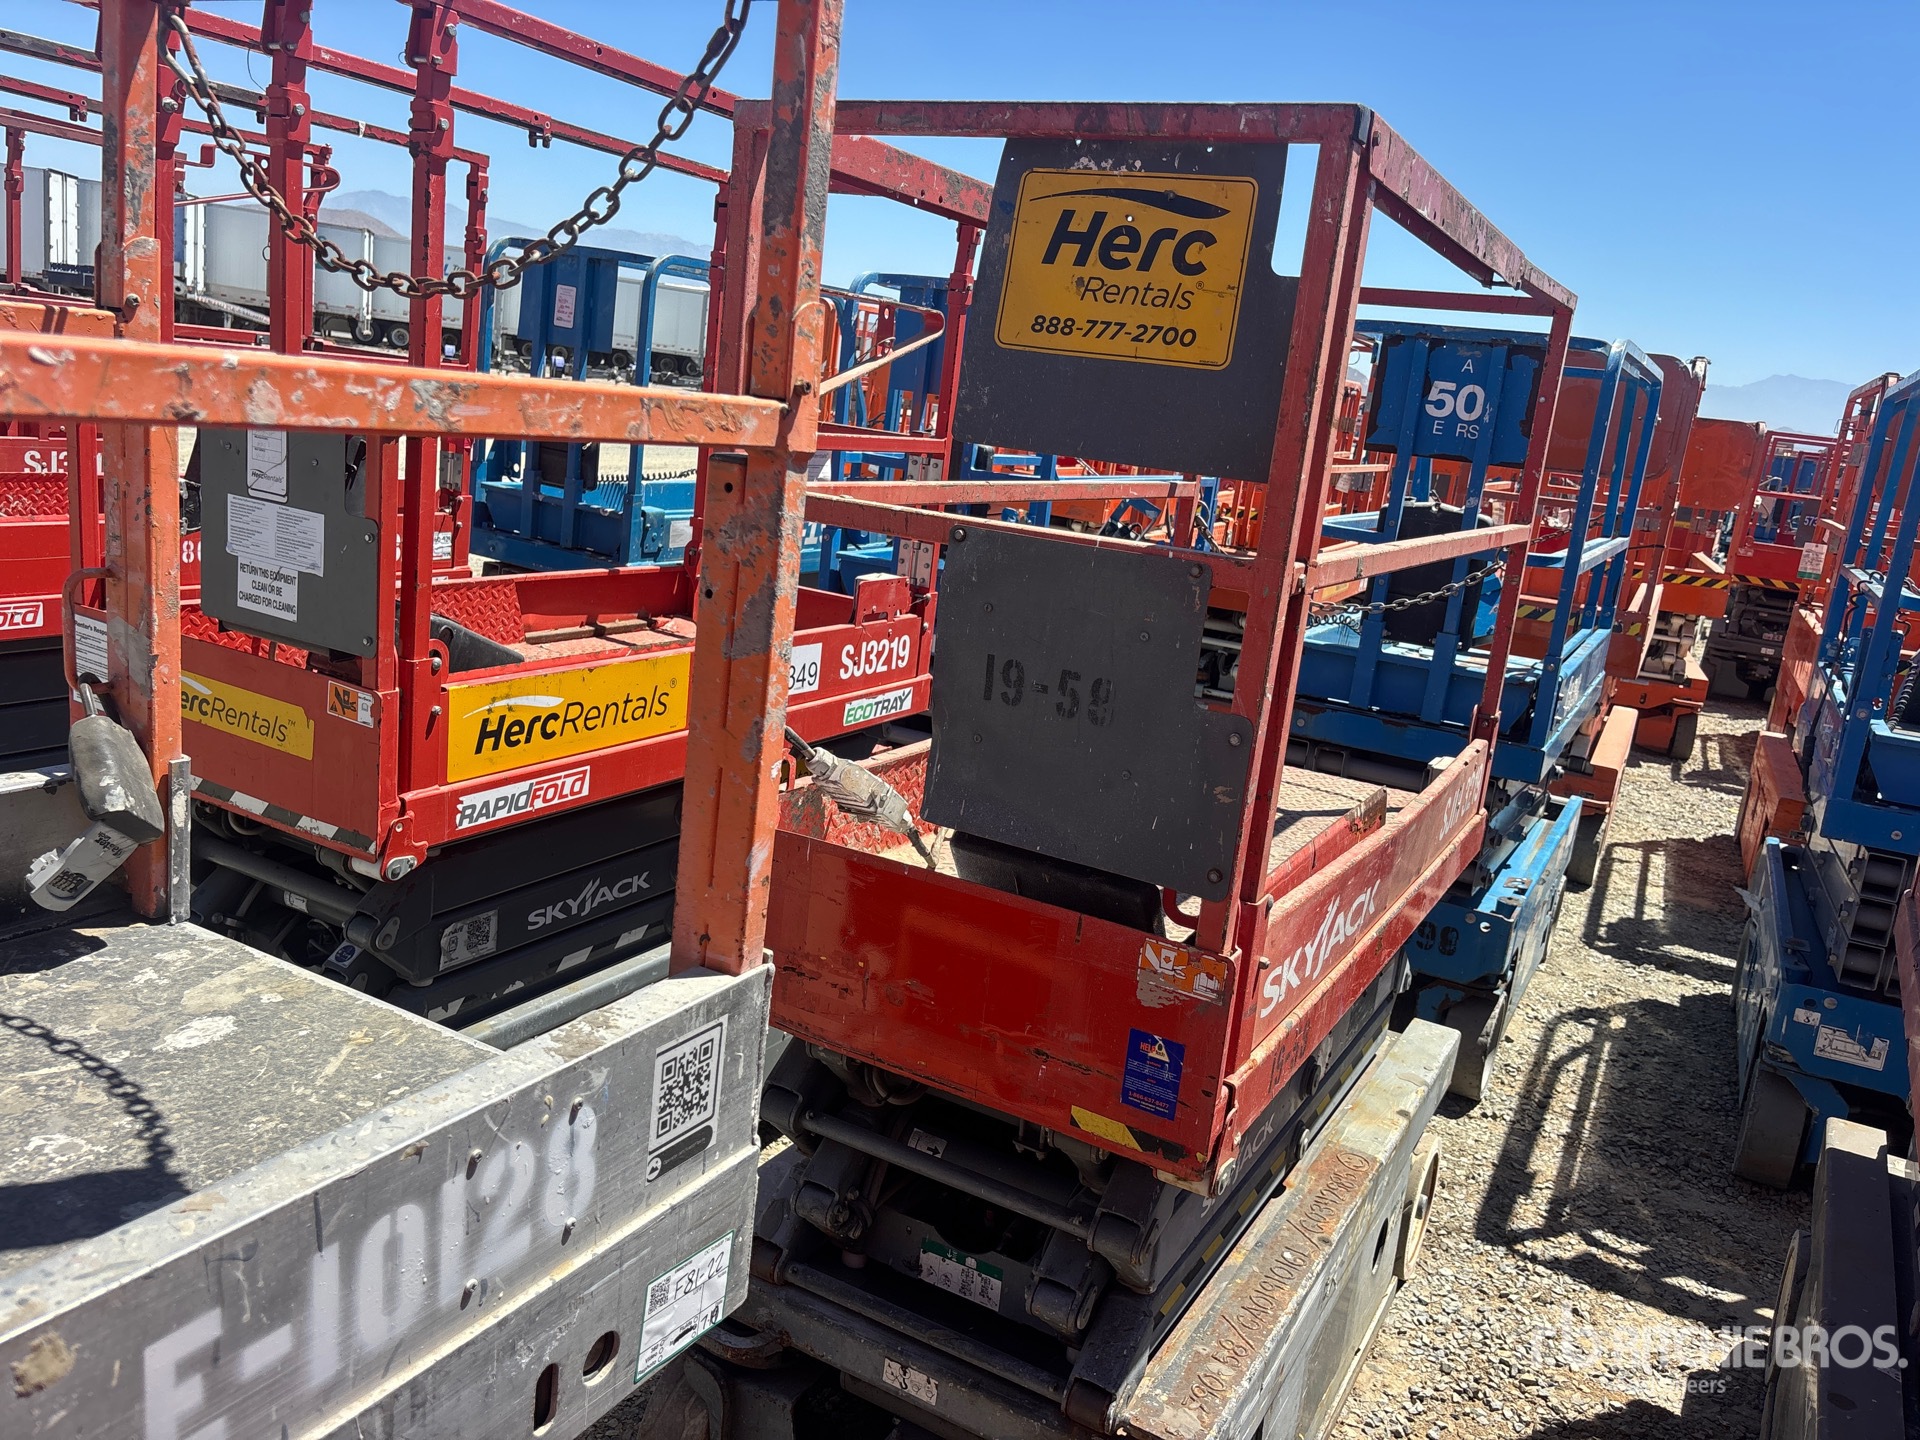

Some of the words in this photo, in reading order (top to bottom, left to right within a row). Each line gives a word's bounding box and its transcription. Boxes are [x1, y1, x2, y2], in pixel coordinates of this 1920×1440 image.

[1041, 209, 1218, 277] Herc
[1080, 276, 1195, 310] Rentals
[1030, 314, 1197, 348] 888-777-2700
[1460, 359, 1474, 374] A
[1425, 380, 1486, 421] 50
[239, 562, 259, 577] RETURN
[259, 568, 270, 579] THIS
[270, 570, 297, 587] EQUIPMENT
[251, 579, 268, 593] CLEAN
[268, 584, 276, 595] OR
[276, 586, 283, 597] BE
[239, 590, 261, 606] CHARGED
[261, 595, 272, 608] FOR
[272, 599, 296, 615] CLEANING
[839, 635, 911, 680] SJ3219
[844, 688, 912, 725] ECOTRAY
[983, 653, 1114, 727] 19-58
[181, 690, 288, 742] ercRentals
[528, 871, 650, 931] SKYJACK
[1260, 879, 1381, 1019] SKYJACK
[144, 1105, 598, 1440] E-10128
[673, 1251, 725, 1301] F81-22
